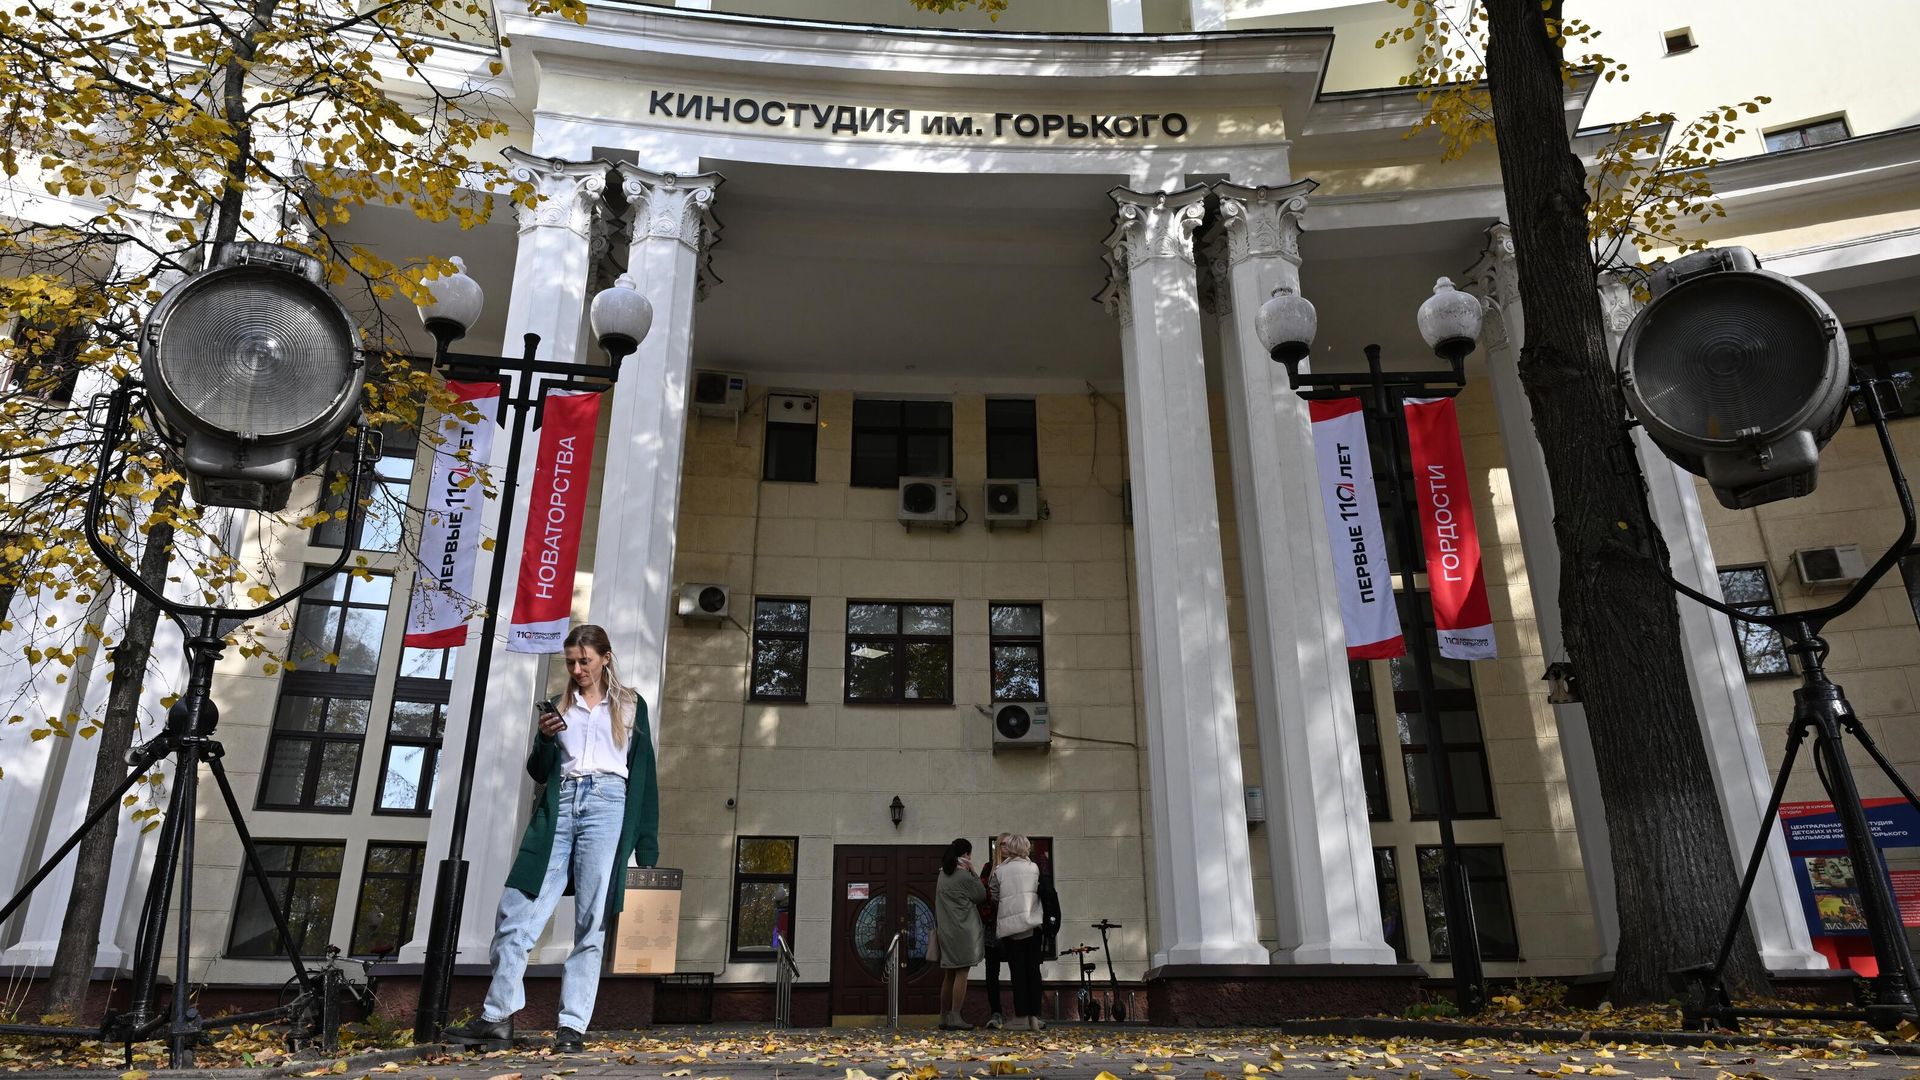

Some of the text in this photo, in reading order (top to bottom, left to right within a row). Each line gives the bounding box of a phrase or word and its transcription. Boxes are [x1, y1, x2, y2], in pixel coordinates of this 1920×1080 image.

[649, 90, 910, 135] КИНОСТУДИЯ
[994, 112, 1188, 138] ГОРЬКОГО
[438, 511, 464, 591] ПЕРВЫЕ
[535, 435, 577, 599] НОВАТОРСТВА
[1334, 443, 1375, 604] ПЕРВЫЕ 110 ЛЕТ
[1427, 465, 1462, 582] ГОРДОСТИ
[1790, 822, 1842, 830] ЦЕНТРАЛЬНАЯ
[1791, 828, 1825, 836] ДЕТСКИХ
